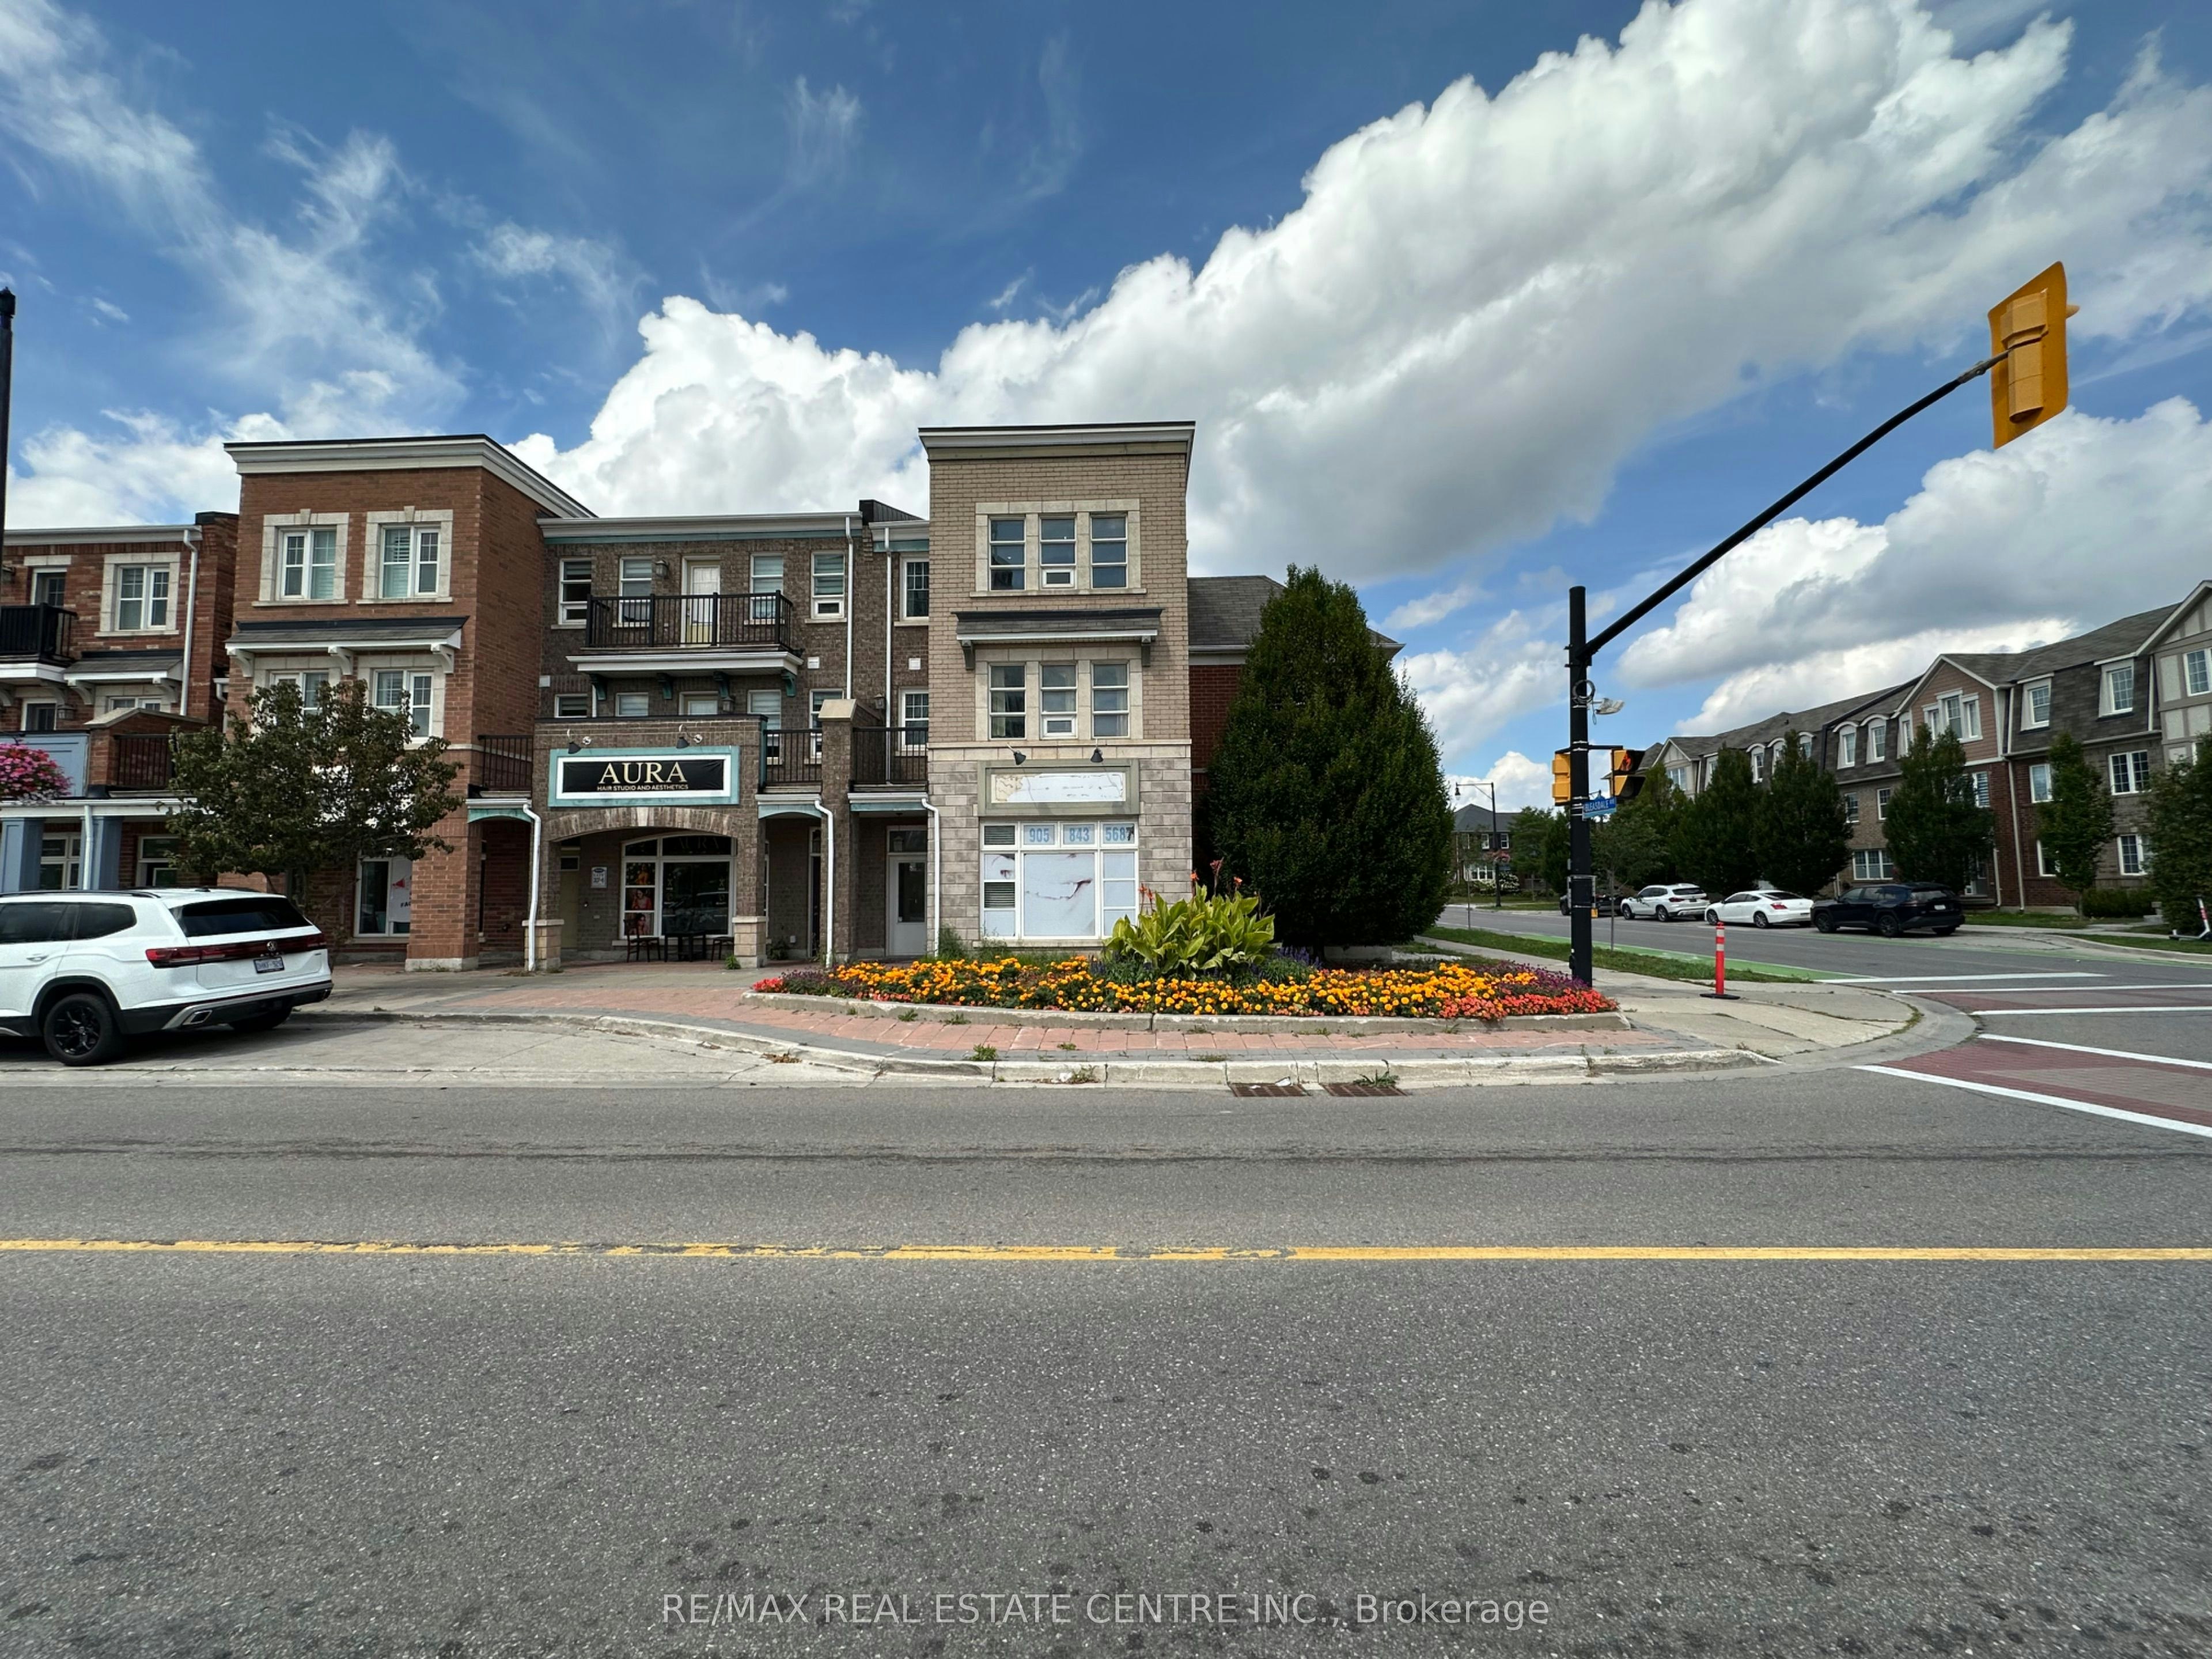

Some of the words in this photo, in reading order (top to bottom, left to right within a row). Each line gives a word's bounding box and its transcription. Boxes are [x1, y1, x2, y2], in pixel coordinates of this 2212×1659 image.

[599, 762, 687, 784] AURA
[1029, 828, 1050, 842] 905
[1069, 827, 1090, 842] 843
